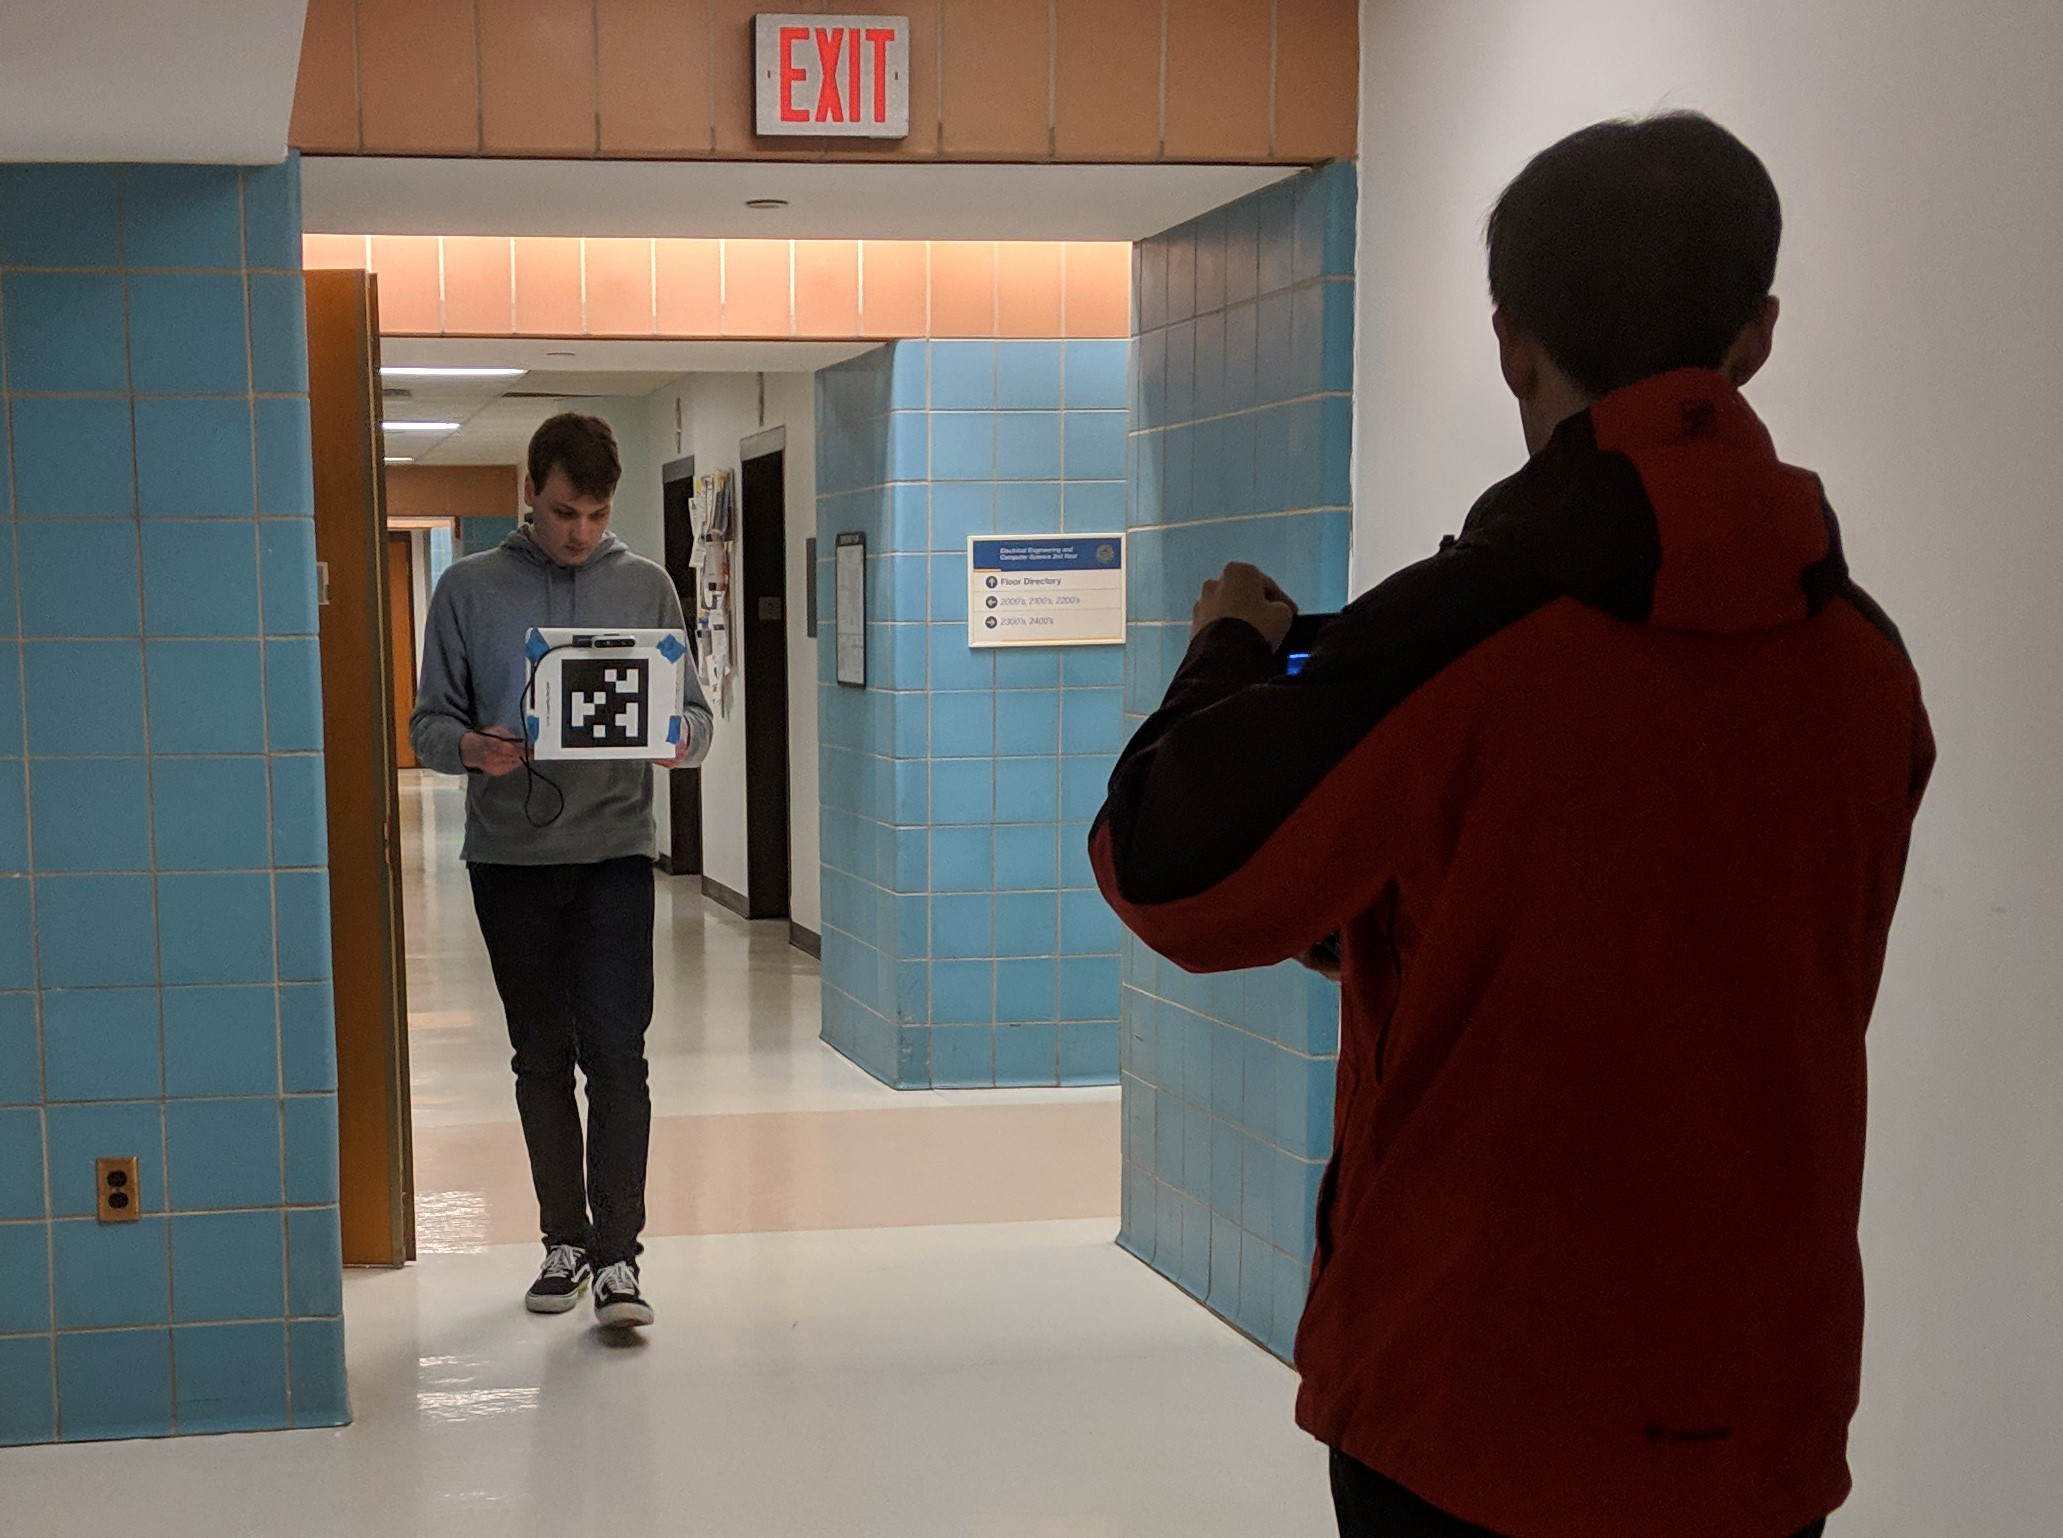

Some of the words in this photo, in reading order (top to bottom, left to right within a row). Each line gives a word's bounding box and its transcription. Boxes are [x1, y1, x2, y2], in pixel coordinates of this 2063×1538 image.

[780, 27, 895, 123] EXIT
[1000, 578, 1021, 586] Floor
[1024, 577, 1062, 586] Directory
